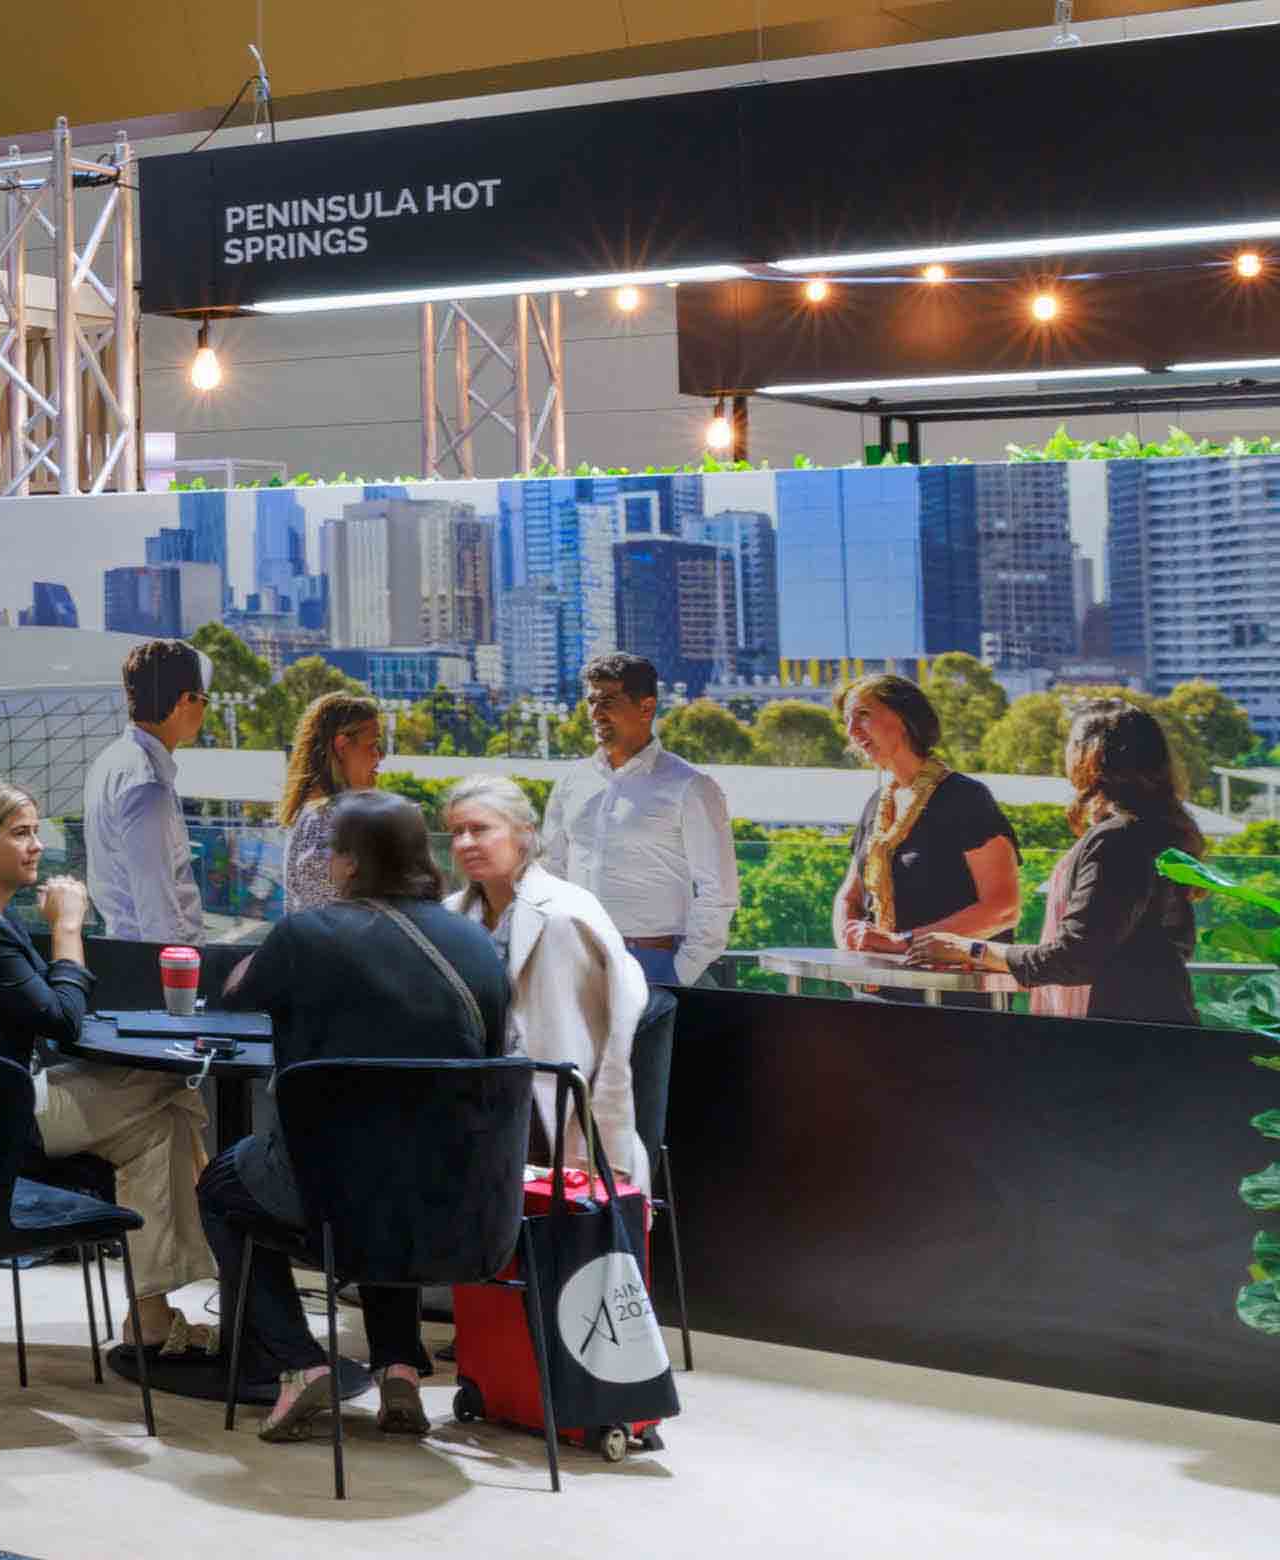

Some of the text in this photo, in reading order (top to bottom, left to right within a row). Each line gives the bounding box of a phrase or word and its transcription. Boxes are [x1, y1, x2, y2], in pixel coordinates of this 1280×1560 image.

[225, 179, 502, 233] PENINSULA HOT
[224, 226, 368, 264] SPRINGS
